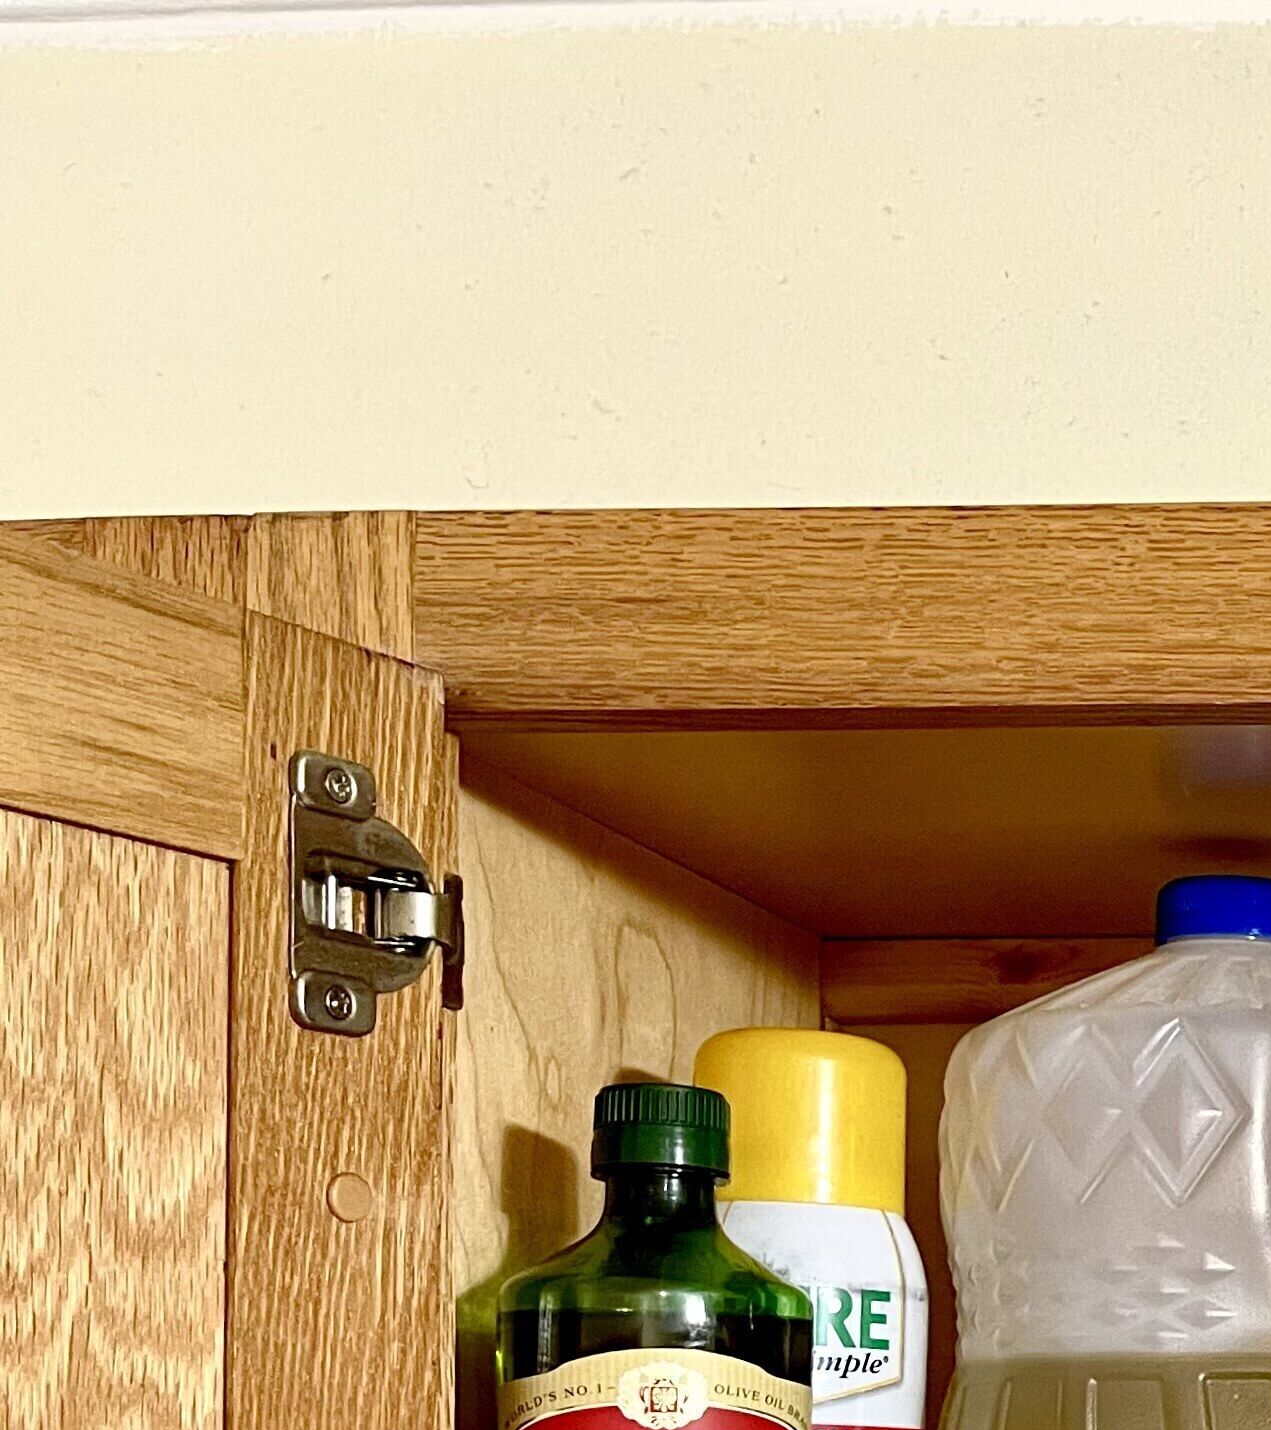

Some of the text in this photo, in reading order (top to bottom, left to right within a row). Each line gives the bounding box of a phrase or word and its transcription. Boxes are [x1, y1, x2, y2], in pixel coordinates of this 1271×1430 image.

[815, 1286, 890, 1350] RE
[714, 1383, 761, 1402] OLIVE
[765, 1394, 785, 1410] OIL
